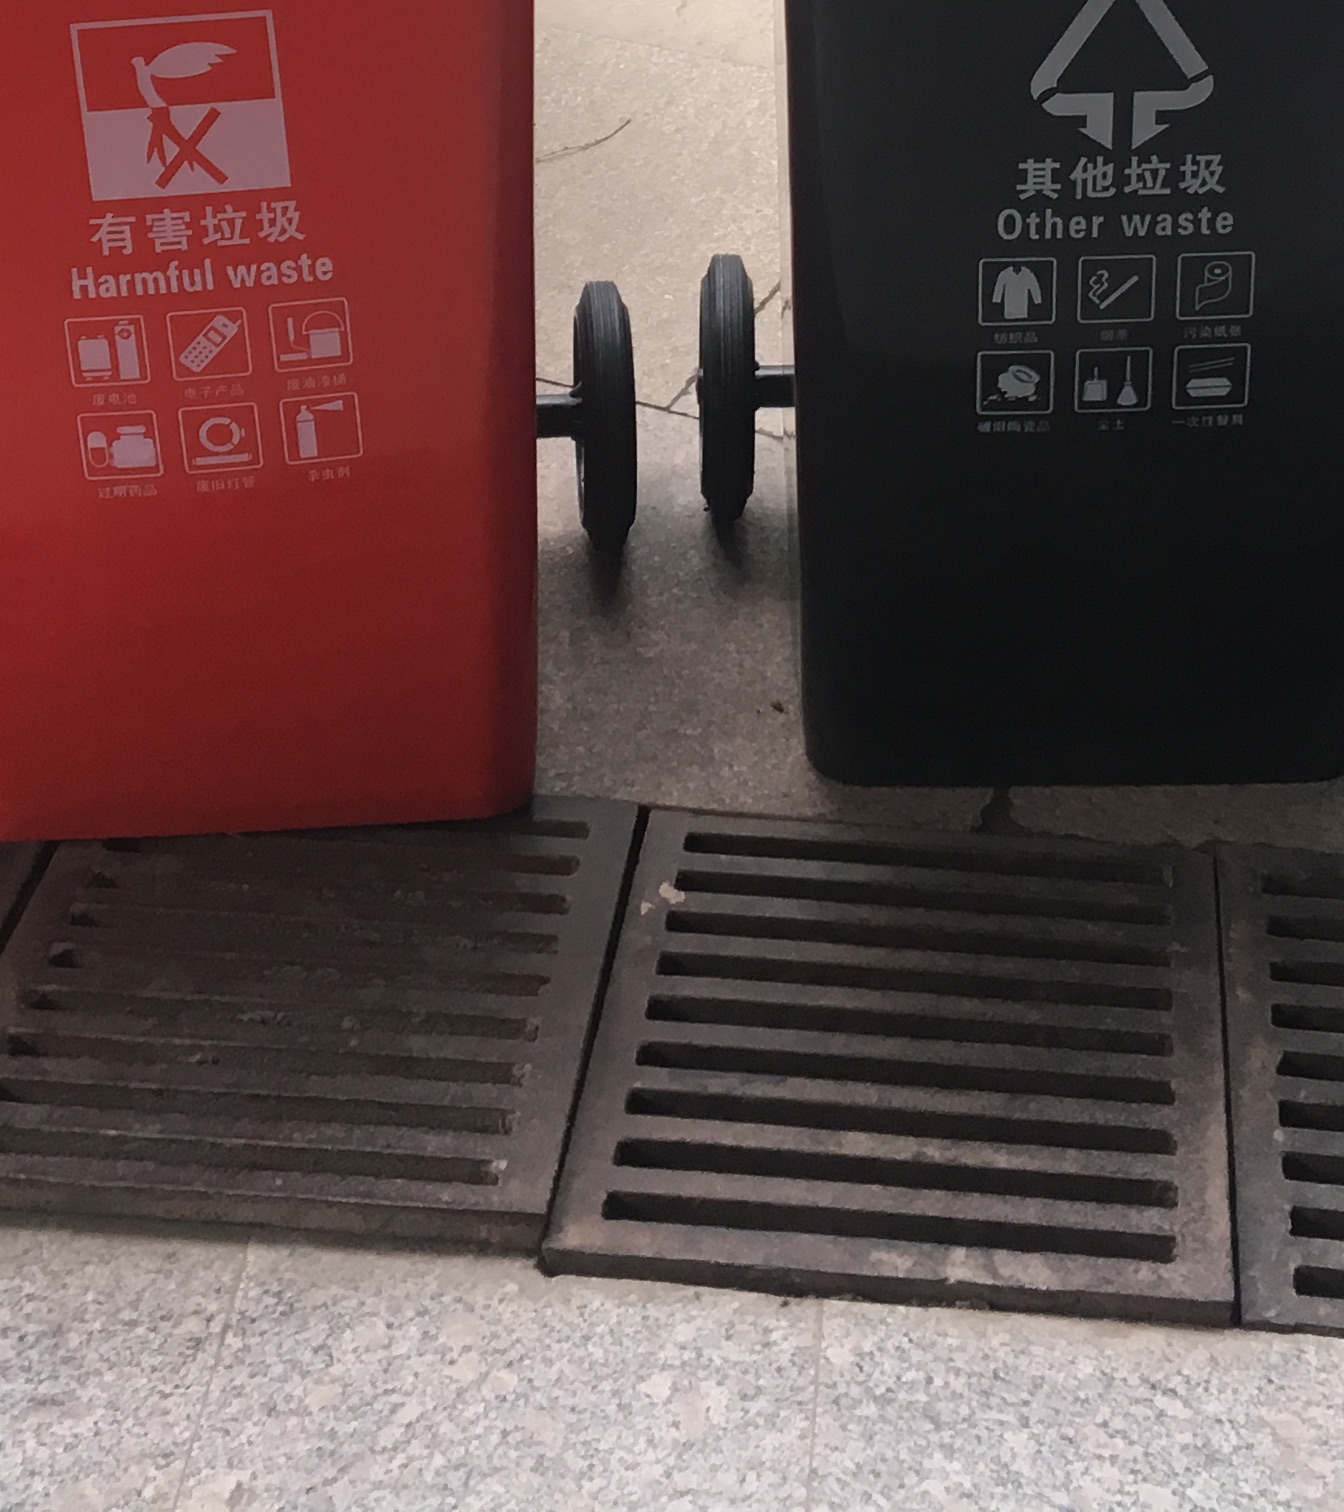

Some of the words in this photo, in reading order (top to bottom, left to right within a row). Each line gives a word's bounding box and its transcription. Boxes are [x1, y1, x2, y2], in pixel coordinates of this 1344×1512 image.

[1016, 154, 1226, 199] 其他垃圾
[89, 200, 306, 256] 有害垃圾
[997, 208, 1104, 240] Other
[1121, 206, 1234, 237] waste
[71, 258, 214, 299] Harmful
[226, 253, 333, 287] waste
[184, 384, 245, 400] 电子产品
[1171, 414, 1244, 428] 一次性餐具
